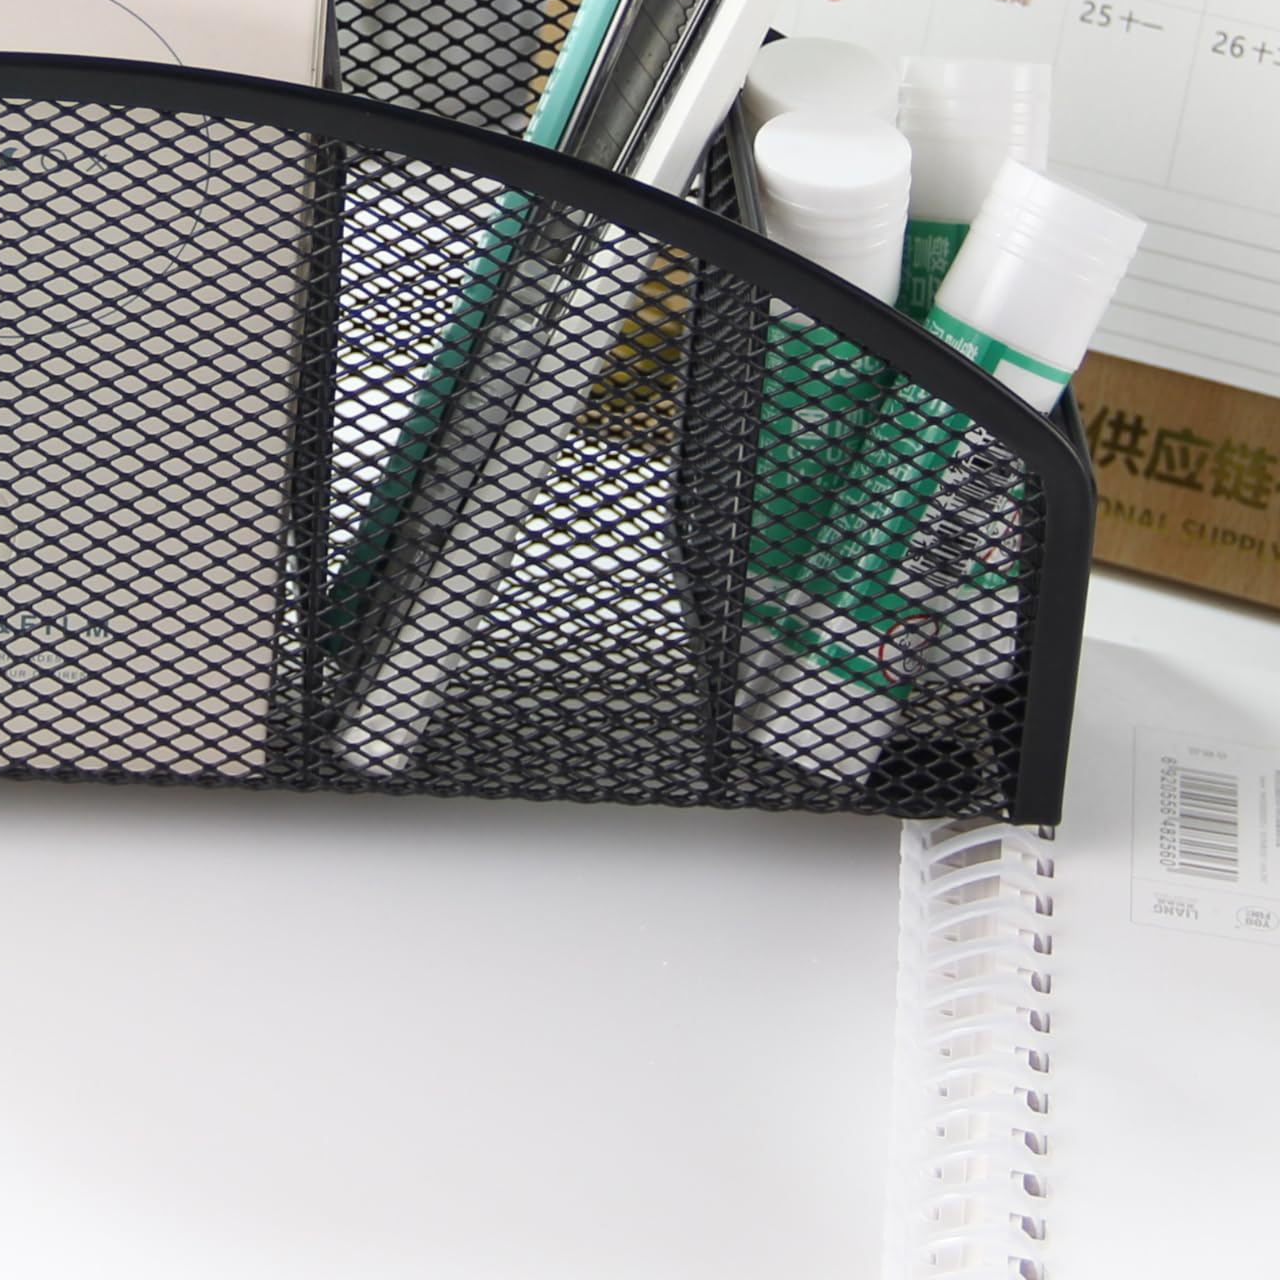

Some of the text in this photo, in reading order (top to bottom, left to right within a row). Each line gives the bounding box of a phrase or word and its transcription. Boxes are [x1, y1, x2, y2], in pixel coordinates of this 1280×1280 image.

[1079, 0, 1164, 33] 25 十一
[1211, 29, 1246, 59] 26
[1079, 403, 1280, 511] 供应链
